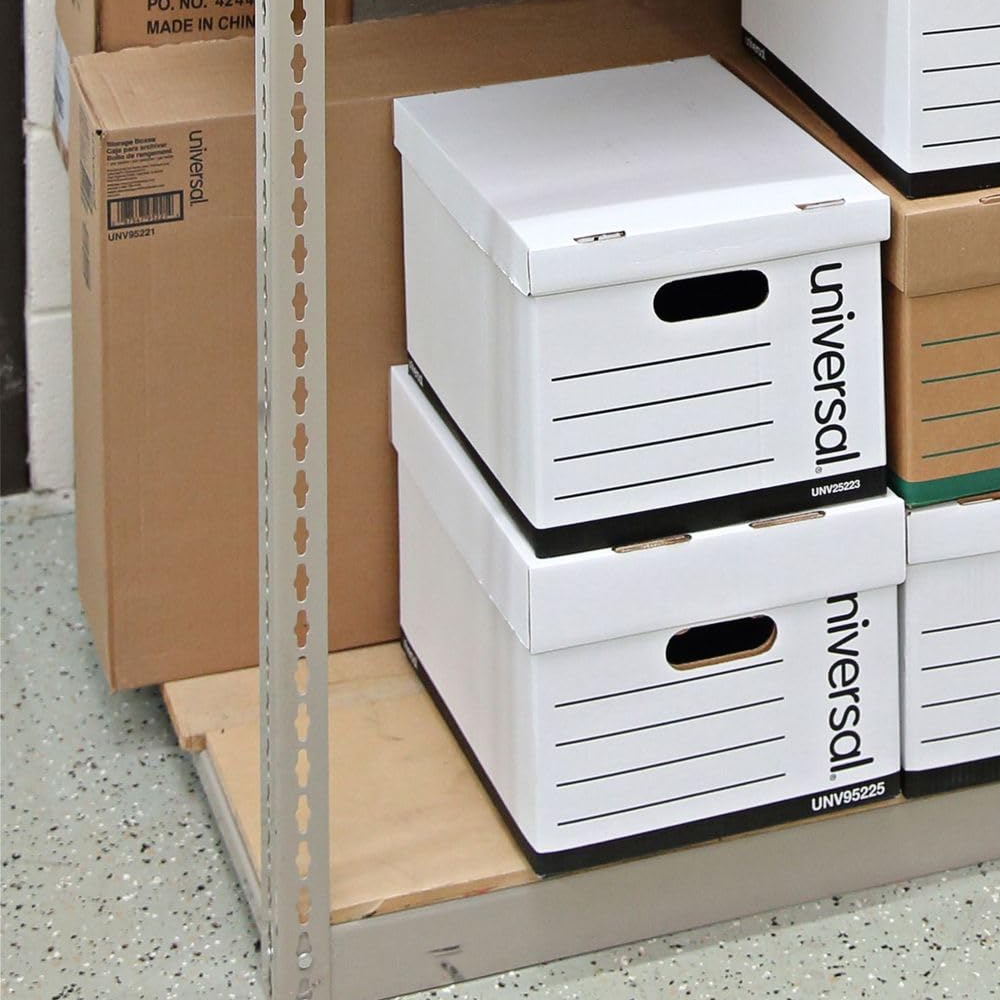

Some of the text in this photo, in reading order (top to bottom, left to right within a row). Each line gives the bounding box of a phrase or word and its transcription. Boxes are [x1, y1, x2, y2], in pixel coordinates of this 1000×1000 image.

[147, 15, 255, 35] MADE IN CHIN
[189, 130, 208, 204] universal
[108, 228, 155, 242] UNV95221
[810, 262, 861, 466] universal
[810, 478, 861, 497] UNV25223
[826, 591, 875, 775] niversal
[810, 782, 886, 812] UNV95225
